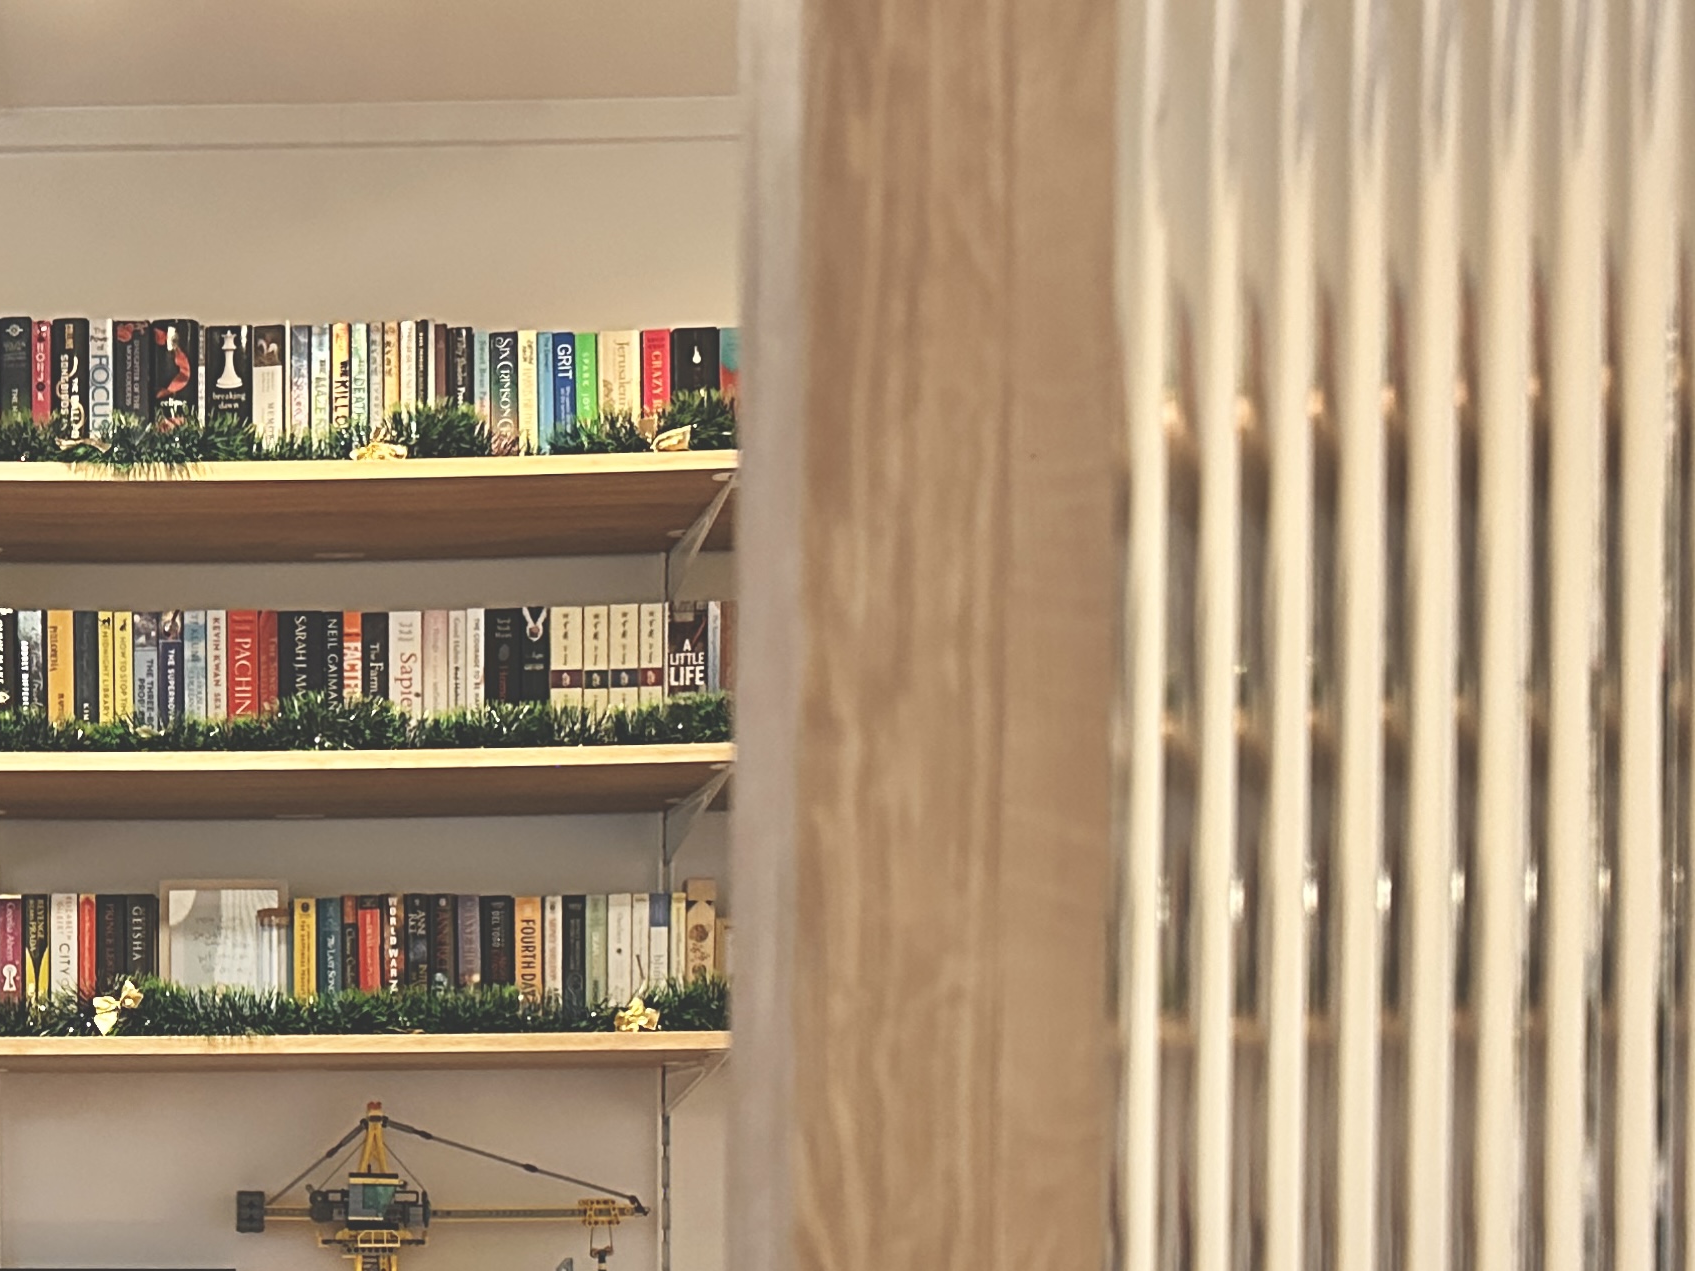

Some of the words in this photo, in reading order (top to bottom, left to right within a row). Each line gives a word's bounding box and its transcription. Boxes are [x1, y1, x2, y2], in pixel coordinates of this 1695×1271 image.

[557, 344, 572, 380] GRIT
[581, 353, 591, 387] SPARK
[650, 351, 663, 396] CRAZY
[581, 393, 591, 411] JOY
[212, 617, 222, 651] KEVIN
[294, 615, 307, 661] SARAH
[327, 618, 338, 649] NEIL
[682, 638, 692, 652] A
[119, 661, 128, 672] TO
[145, 659, 155, 678] THE
[167, 648, 175, 666] THE
[212, 654, 222, 687] KWAN
[669, 652, 705, 665] LITTLE
[119, 674, 128, 697] STOP
[234, 638, 253, 716] PACHIN
[327, 653, 338, 711] GAIMAN
[369, 661, 384, 693] Farm
[669, 665, 705, 687] LIFE
[82, 702, 90, 721] KIM
[212, 692, 222, 710] SEX
[29, 921, 37, 952] PRADA
[132, 906, 143, 962] GEISHA
[388, 897, 399, 946] WORLD
[58, 942, 71, 975] CITY
[520, 919, 537, 970] FOURTH
[388, 948, 399, 978] WAR
